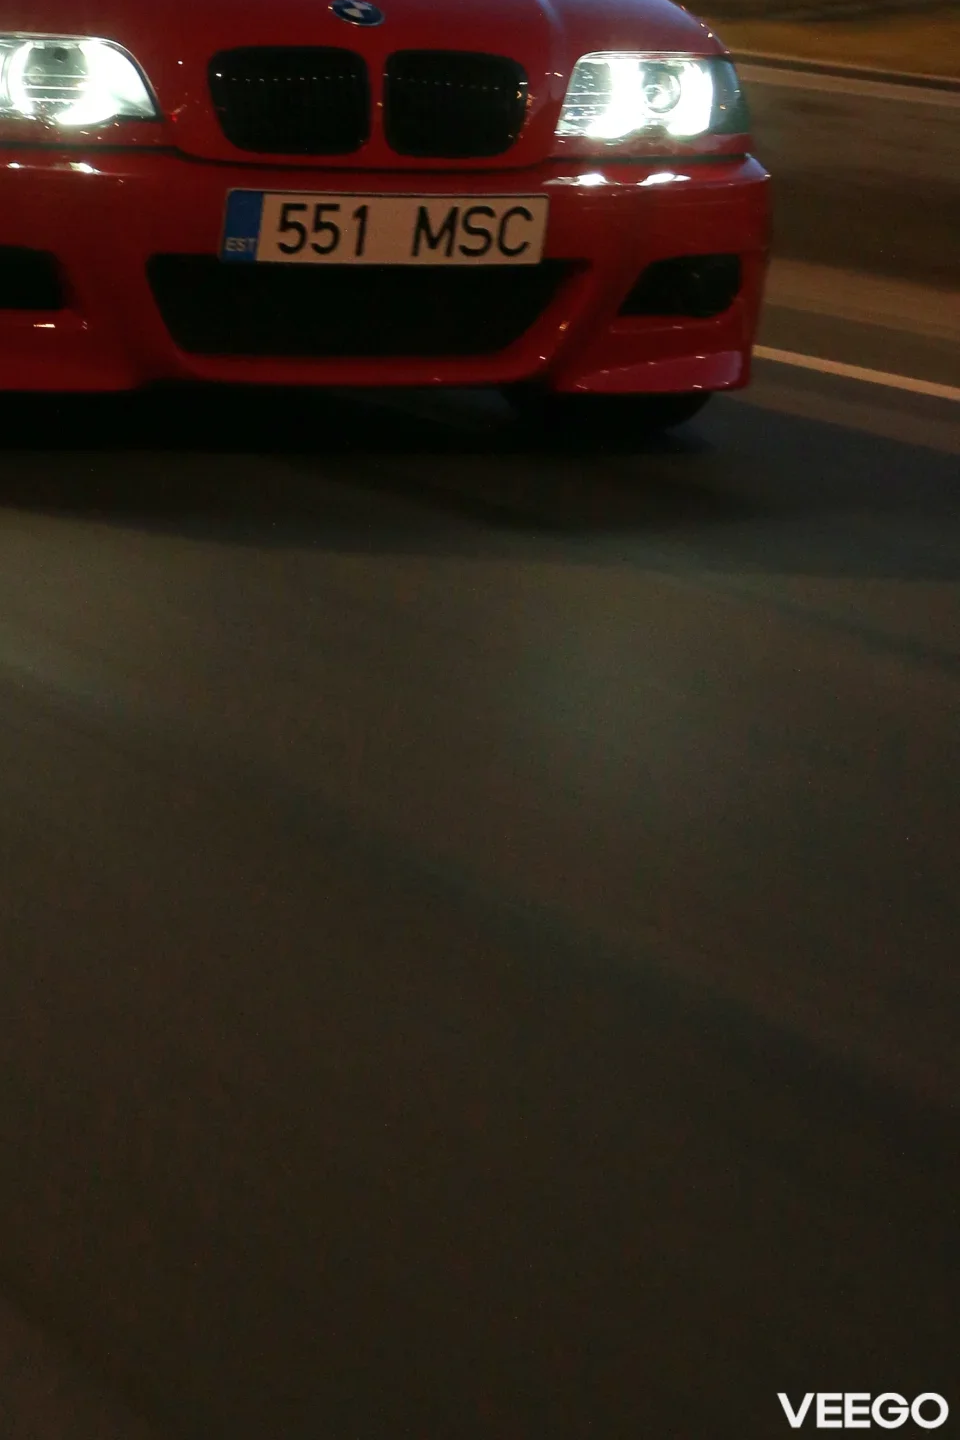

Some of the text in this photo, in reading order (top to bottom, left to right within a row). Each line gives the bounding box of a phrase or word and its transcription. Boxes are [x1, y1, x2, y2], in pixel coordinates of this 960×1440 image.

[226, 236, 257, 252] EST
[276, 203, 534, 257] 551 MSC
